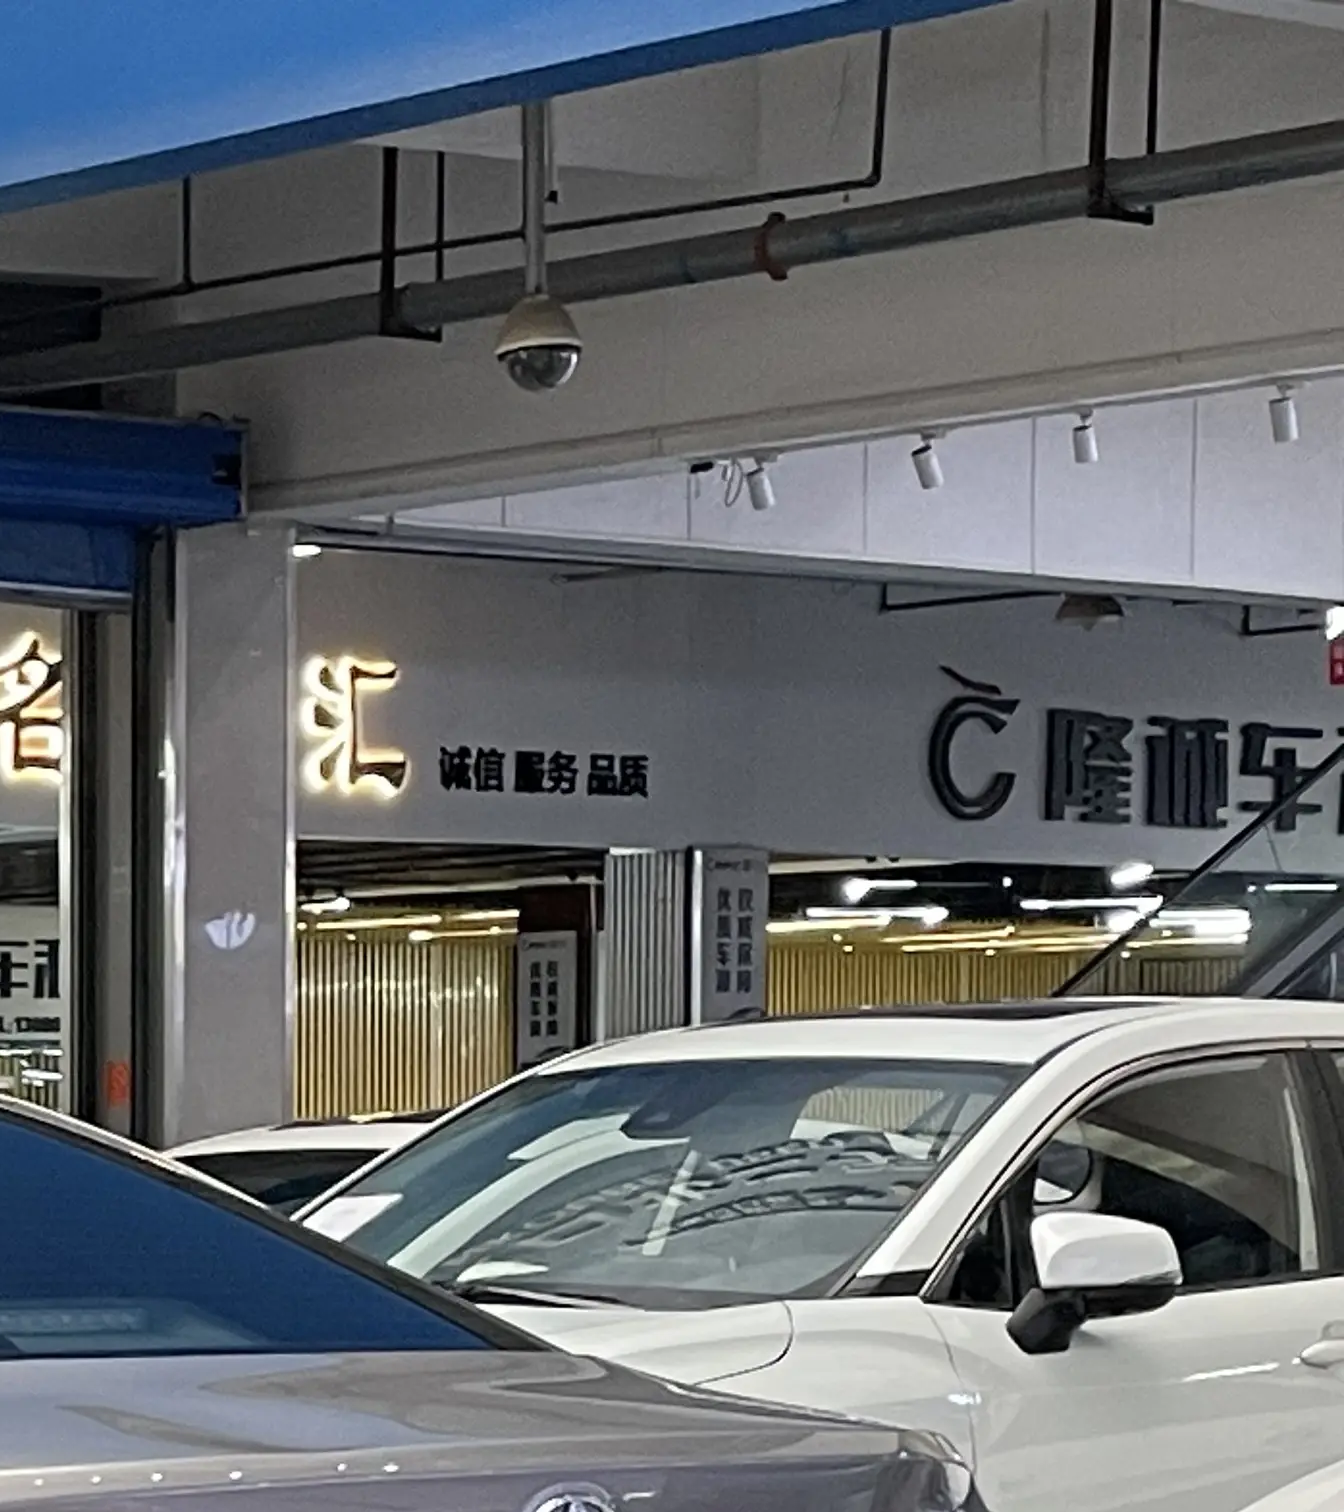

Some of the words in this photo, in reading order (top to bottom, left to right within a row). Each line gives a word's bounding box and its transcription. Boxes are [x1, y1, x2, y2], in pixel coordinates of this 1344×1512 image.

[438, 745, 506, 793] 诚信
[514, 750, 578, 796] 服务
[587, 753, 650, 799] 品质
[1042, 708, 1344, 837] 隆通车
